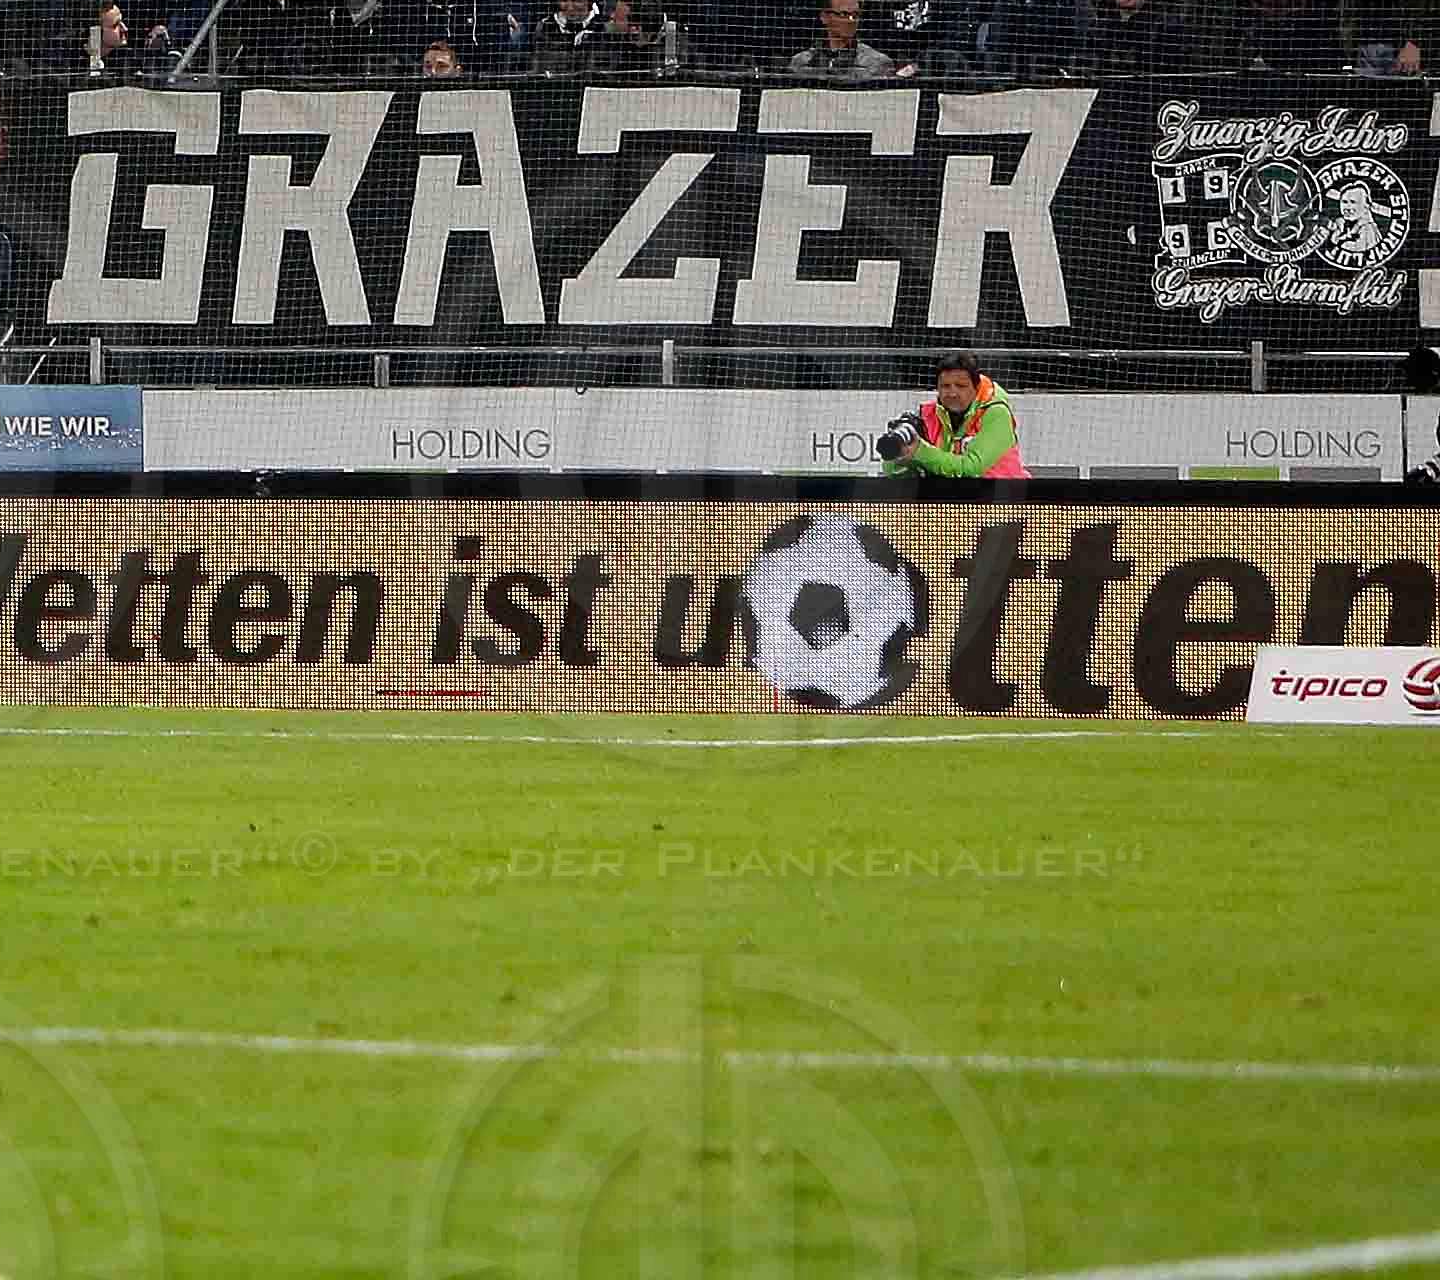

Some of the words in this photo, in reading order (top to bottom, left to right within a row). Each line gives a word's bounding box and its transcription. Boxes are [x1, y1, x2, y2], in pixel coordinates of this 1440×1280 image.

[46, 85, 1099, 330] GRAZER
[2, 416, 57, 437] WIE
[391, 429, 551, 461] HOLDING
[1225, 429, 1382, 461] HOLDING
[429, 534, 612, 669] ist
[1271, 669, 1388, 701] tipico
